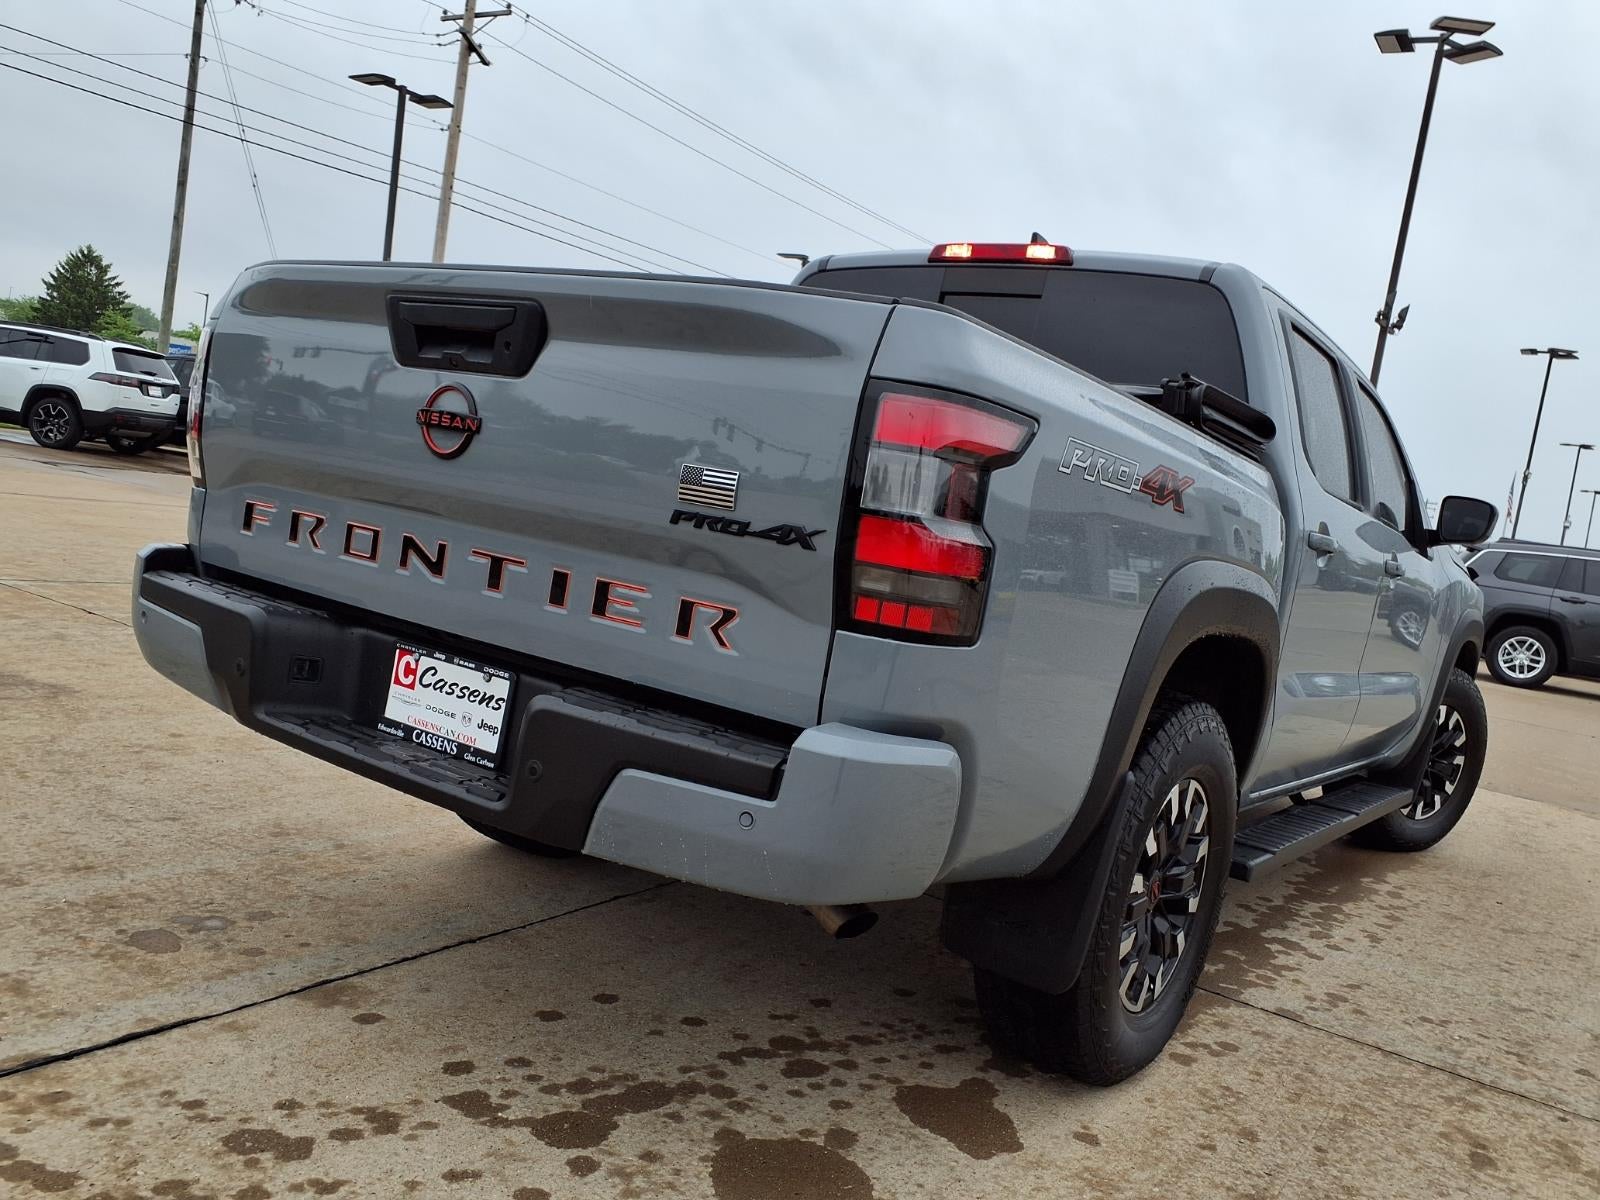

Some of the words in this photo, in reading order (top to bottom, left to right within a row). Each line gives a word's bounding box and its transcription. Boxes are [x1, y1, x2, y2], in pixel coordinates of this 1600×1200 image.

[418, 409, 478, 432] NISSAN
[669, 509, 828, 552] PRO-4X
[239, 498, 740, 655] FRONTIER
[433, 651, 446, 661] Jeep
[397, 654, 416, 686] C
[418, 666, 506, 712] Cassens
[483, 666, 510, 679] DODGE
[425, 704, 457, 720] DODGE
[407, 714, 477, 747] CASSENSCAN.COM
[477, 718, 499, 737] Jeep
[412, 729, 458, 756] CASSENS
[463, 752, 476, 763] Glen
